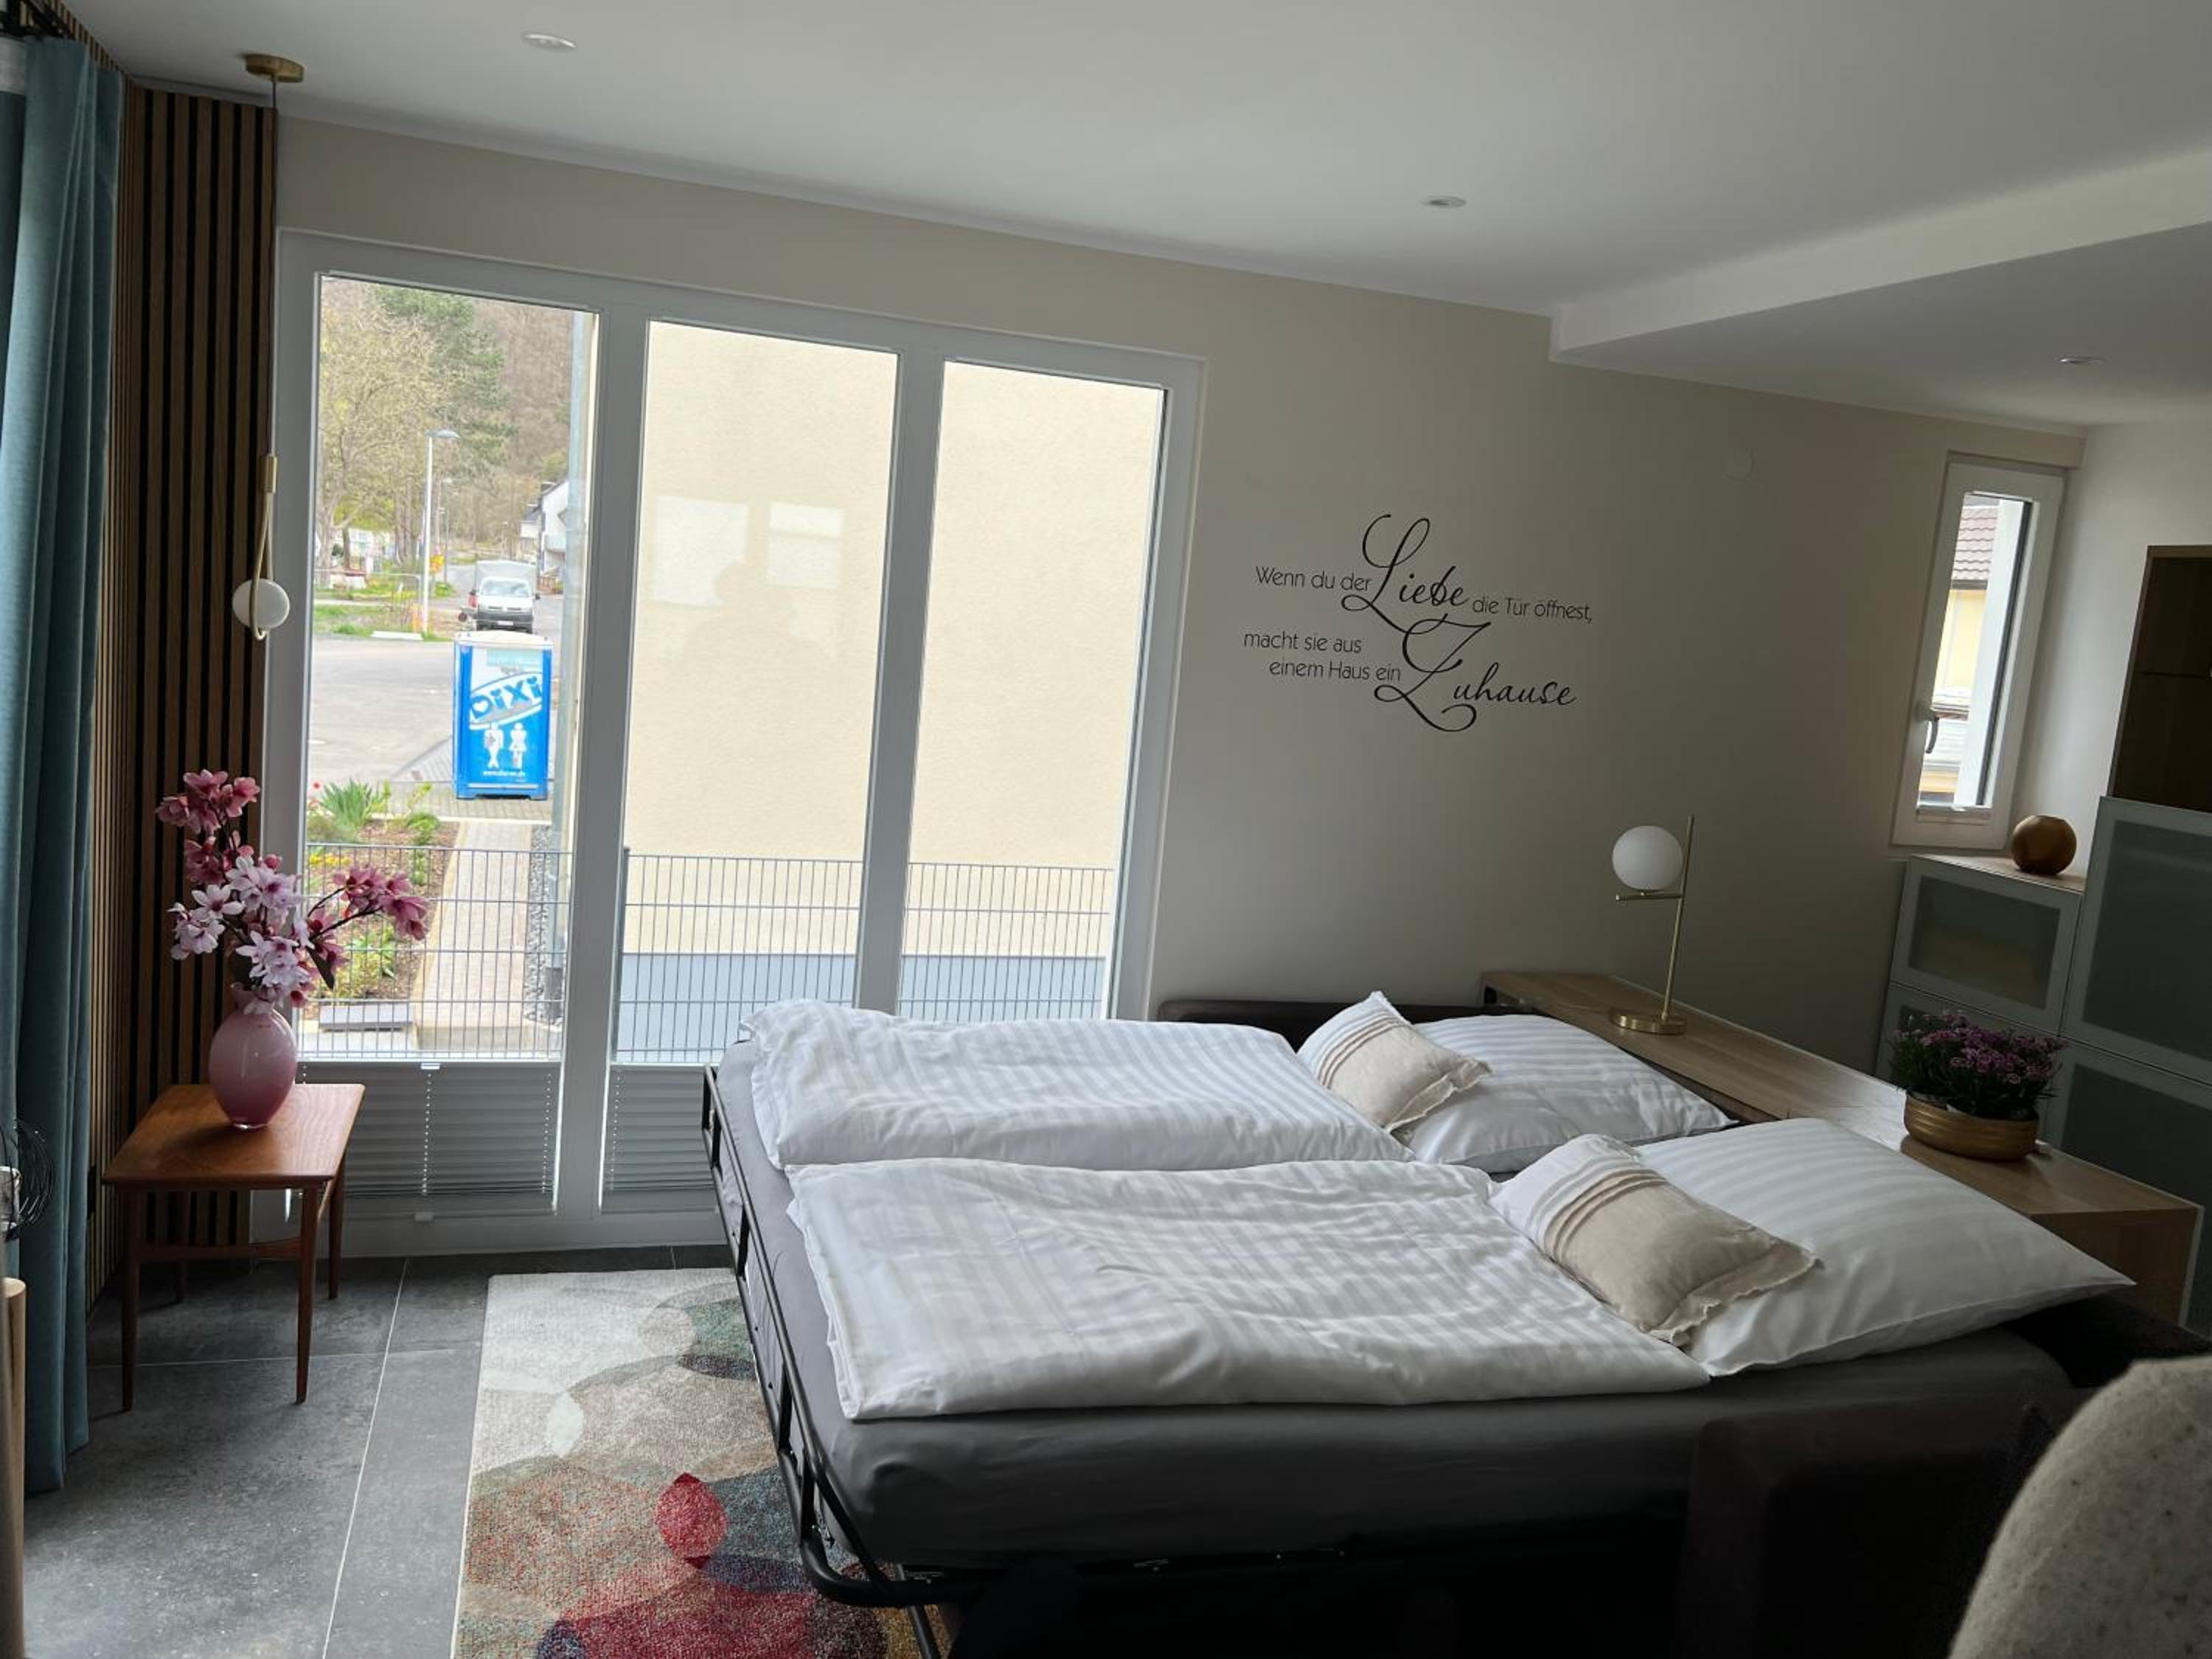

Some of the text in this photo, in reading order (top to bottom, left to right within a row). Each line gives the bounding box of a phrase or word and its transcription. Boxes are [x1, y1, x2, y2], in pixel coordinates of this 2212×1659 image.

[1255, 566, 1306, 588] Wenn
[1310, 570, 1335, 589] du
[1340, 514, 1470, 634] Liebe
[1340, 572, 1371, 591] der
[1472, 596, 1500, 613] die
[1243, 630, 1363, 653] macht sie aus
[1268, 613, 1577, 732] einem Haus ein Zuhause
